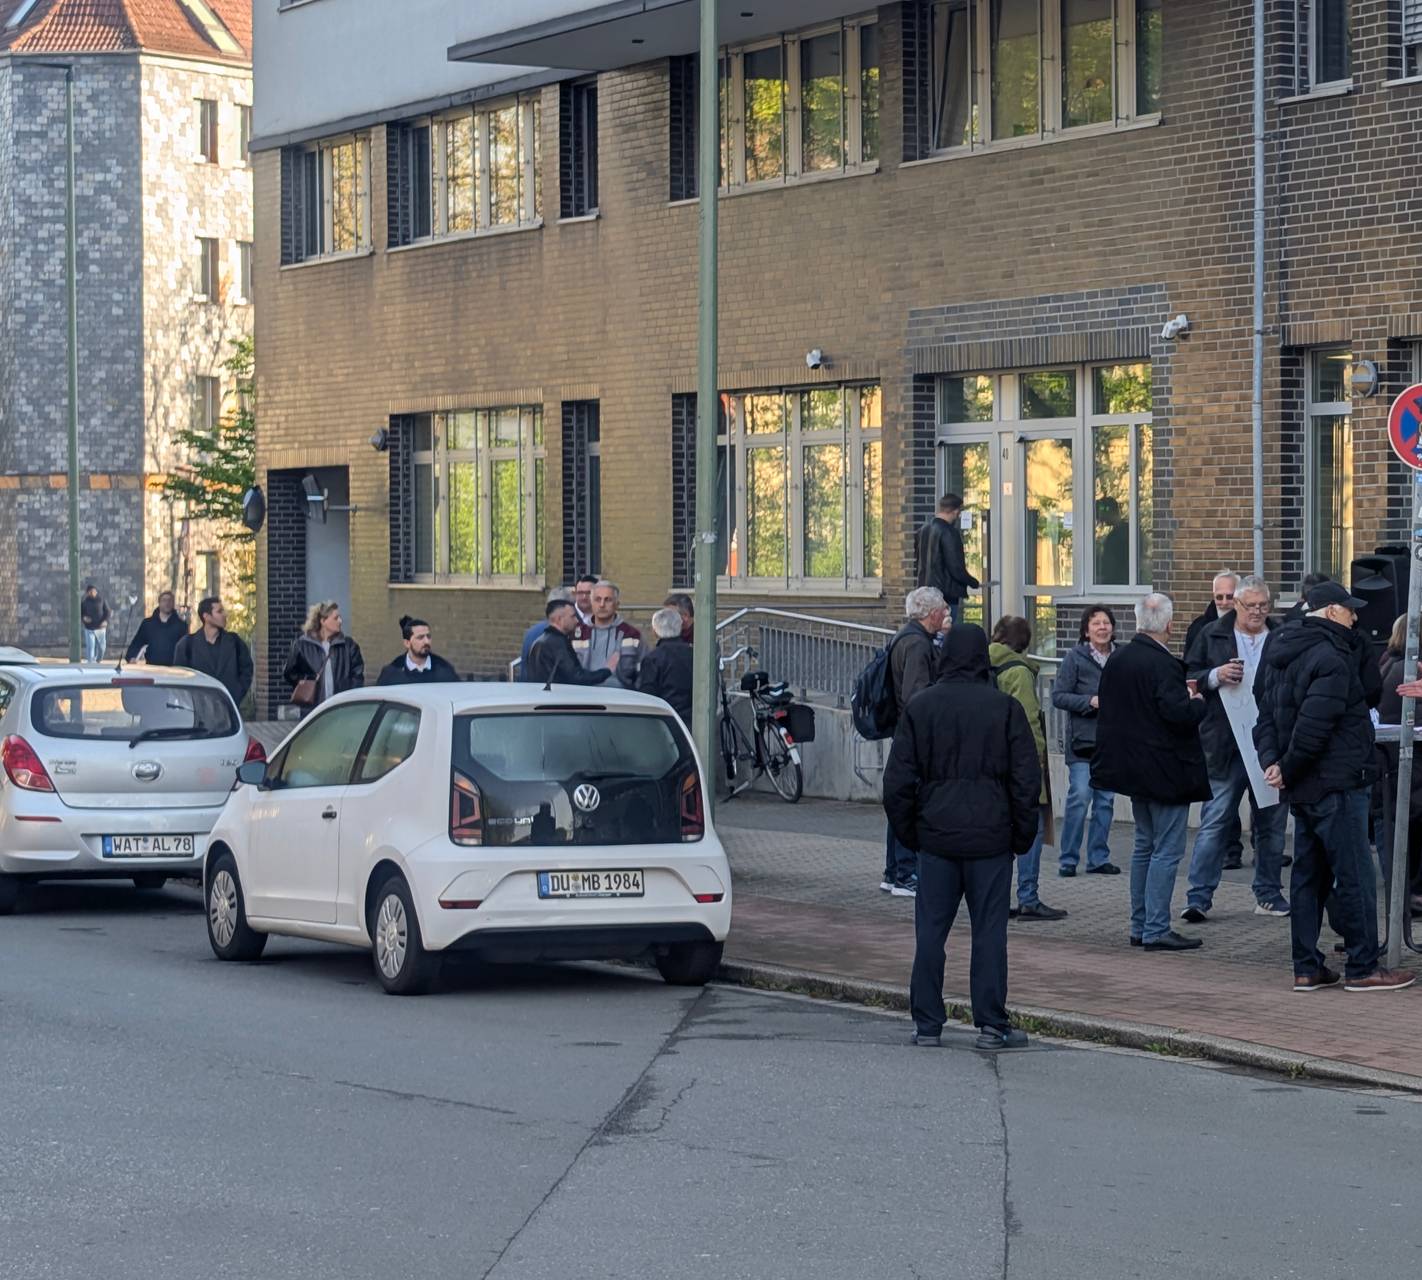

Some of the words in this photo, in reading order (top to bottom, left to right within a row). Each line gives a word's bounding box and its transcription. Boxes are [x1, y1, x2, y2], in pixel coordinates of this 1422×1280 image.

[113, 837, 142, 852] WAT
[152, 837, 171, 852] AL
[173, 837, 191, 851] 78
[550, 875, 570, 891] DU
[581, 874, 601, 890] MB
[604, 873, 640, 890] 1984
